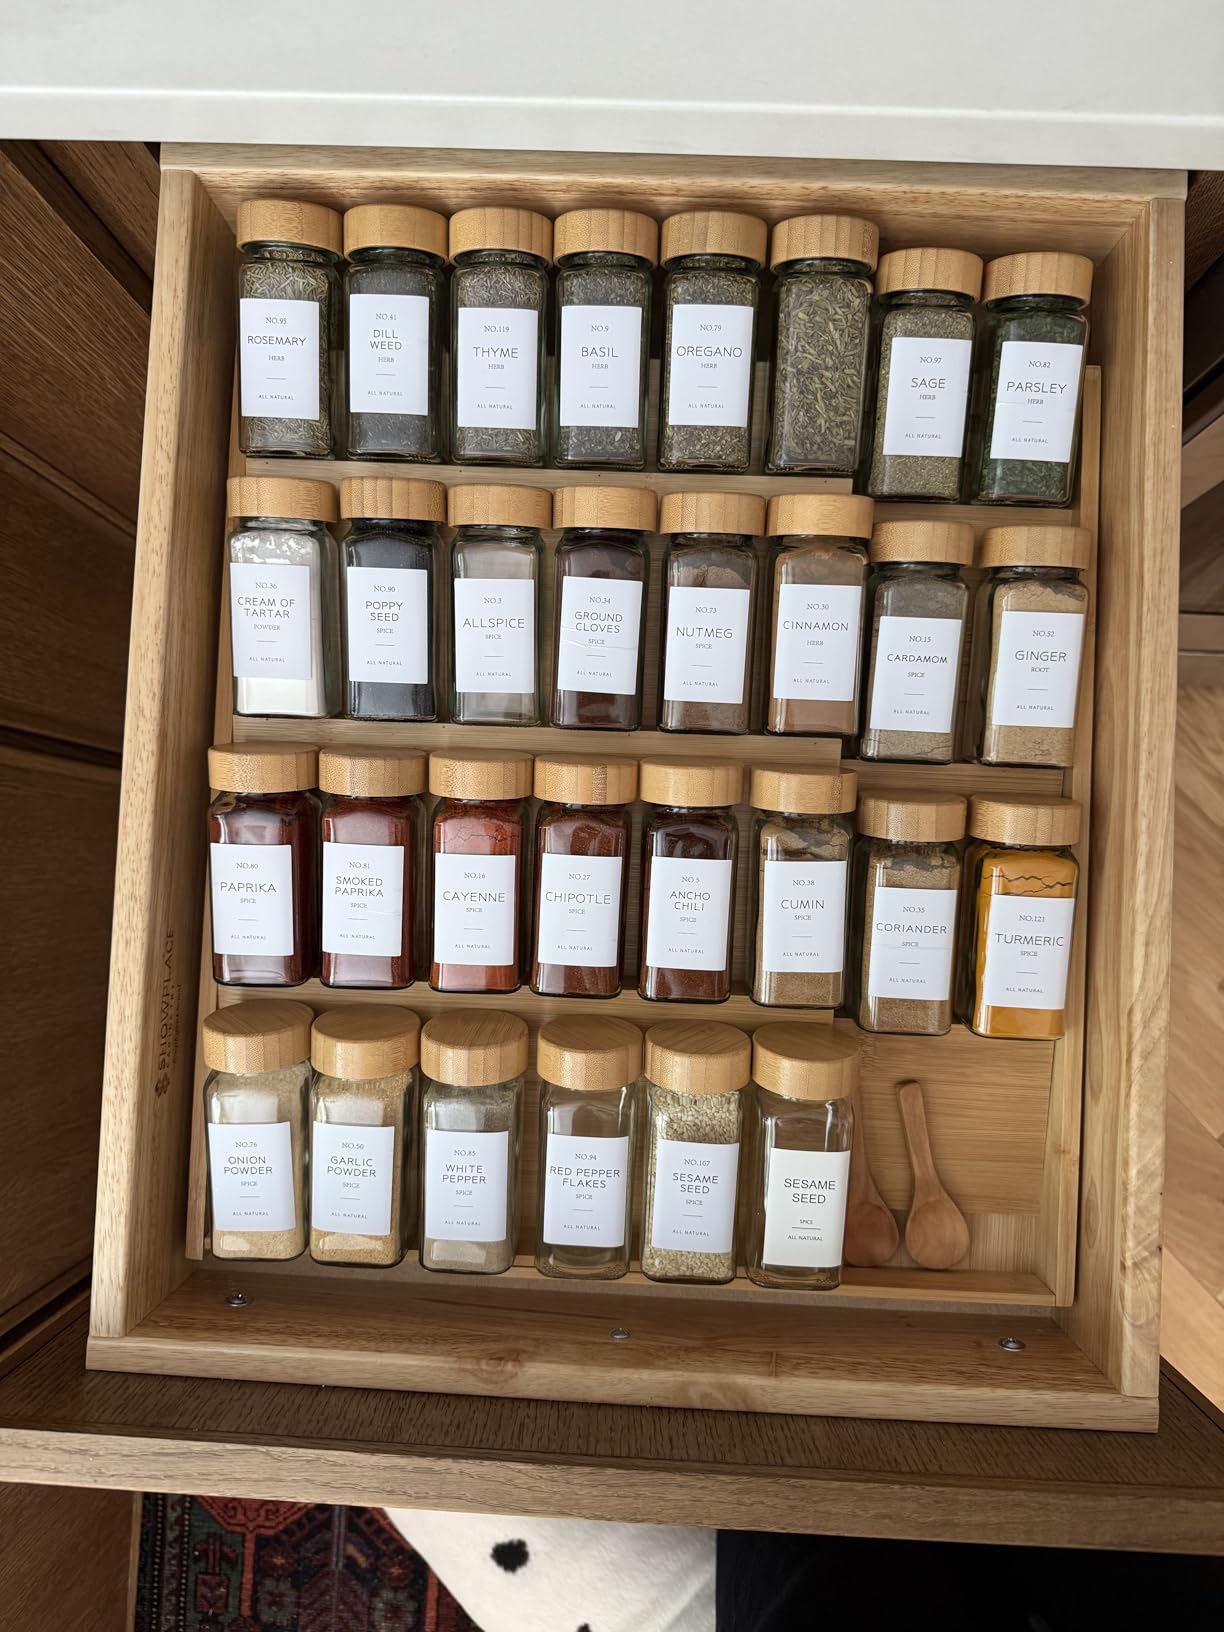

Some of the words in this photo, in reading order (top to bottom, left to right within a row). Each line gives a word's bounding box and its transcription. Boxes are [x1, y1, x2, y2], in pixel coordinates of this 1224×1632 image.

[265, 316, 288, 326] NO.95
[375, 312, 397, 321] NO.41
[483, 324, 510, 333] NO.119
[590, 324, 610, 333] NO.9
[699, 323, 722, 332] NO.79
[372, 328, 399, 340] DILL
[247, 335, 307, 347] ROSEMARY
[369, 340, 403, 351] WEED
[472, 346, 519, 359] THYME
[581, 346, 620, 358] BASIL
[676, 345, 743, 358] OREGANO
[268, 354, 286, 362] HERB
[377, 356, 395, 364] HERB
[919, 355, 943, 366] NO.97
[591, 362, 609, 370] HERB
[1028, 360, 1052, 369] NO.82
[910, 377, 947, 390] SAGE
[1006, 380, 1068, 395] PARSLEY
[919, 393, 936, 401] HERB
[372, 585, 396, 593] NO.90
[236, 596, 277, 608] CREAM
[279, 598, 296, 608] OF
[365, 600, 404, 611] POPPY
[588, 596, 611, 605] NO.34
[243, 607, 290, 619] TARTAR
[695, 606, 718, 614] NO.73
[369, 611, 400, 622] SEED
[574, 610, 623, 623] GROUND
[253, 623, 281, 631] POWDER
[462, 617, 525, 629] ALLSPICE
[574, 622, 621, 634] CLOVES
[782, 620, 849, 632] CINNAMON
[676, 626, 733, 639] NUTMEG
[1032, 629, 1056, 638] NO.52
[588, 638, 606, 646] SPICE
[806, 639, 824, 647] HERB
[908, 634, 932, 644] NO.15
[695, 642, 713, 650] SPICE
[886, 652, 948, 664] CARDAMOM
[1014, 649, 1068, 662] GINGER
[694, 680, 719, 688] NATURAL
[235, 862, 259, 870] NO.80
[335, 875, 384, 887] SMOKED
[463, 872, 486, 880] NO.16
[568, 872, 592, 881] NO.27
[220, 881, 277, 894] PAPRIKA
[792, 879, 816, 887] NO.38
[334, 886, 384, 898] PAPRIKA
[442, 890, 506, 903] CAYENNE
[669, 890, 711, 902] ANCHO
[545, 891, 612, 905] CHIPOTLE
[673, 901, 705, 912] CHILI
[780, 899, 825, 910] CUMIN
[568, 908, 586, 916] SPICE
[1018, 914, 1046, 923] NO.121
[875, 922, 947, 935] CORIANDER
[900, 940, 920, 948] SPICE
[994, 932, 1065, 947] TURMERIC
[1019, 950, 1039, 958] SPICE
[159, 927, 174, 1071] SHOWPLACE
[234, 1140, 258, 1149] NO.76
[227, 1155, 266, 1166] ONION
[330, 1155, 374, 1168] GARLIC
[574, 1152, 598, 1161] NO.94
[683, 1158, 711, 1167] NO.107
[223, 1165, 273, 1176] POWDER
[326, 1165, 377, 1178] POWDER
[445, 1163, 484, 1174] WHITE
[549, 1164, 573, 1176] RED
[576, 1168, 621, 1180] PEPPER
[442, 1174, 487, 1185] PEPPER
[562, 1177, 607, 1190] FLAKES
[672, 1172, 719, 1186] SESAME
[783, 1177, 837, 1191] SESAME
[342, 1182, 361, 1190] SPICE
[680, 1183, 710, 1195] SEED
[791, 1192, 827, 1204] SEED
[342, 1212, 368, 1220] NATURAL
[799, 1218, 814, 1226] SPICE
[575, 1224, 601, 1232] NATURAL
[684, 1229, 710, 1238] NATURAL
[798, 1234, 824, 1242] NATURAL
